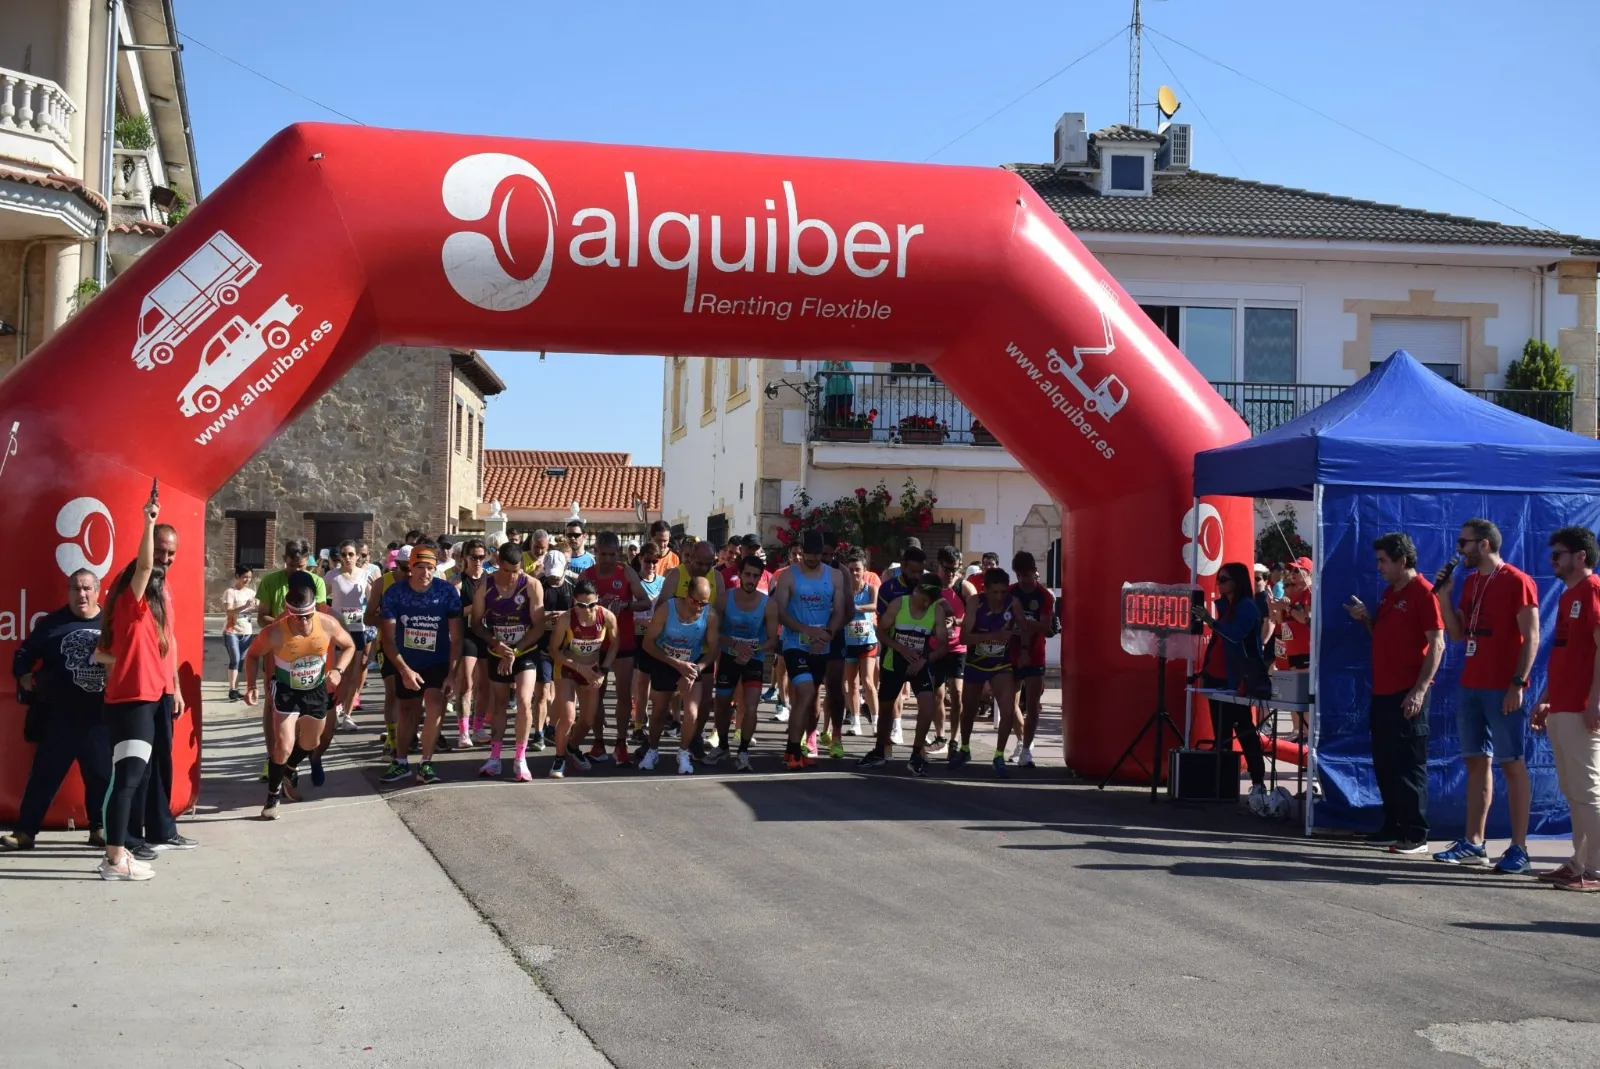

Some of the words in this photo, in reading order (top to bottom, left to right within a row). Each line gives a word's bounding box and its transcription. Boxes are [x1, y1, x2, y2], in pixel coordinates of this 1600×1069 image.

[569, 171, 924, 313] alquiber
[698, 293, 792, 320] Renting
[800, 297, 892, 319] Flexible
[194, 320, 333, 446] www.alquiber.es
[1005, 341, 1116, 460] www.alquiber.es
[503, 633, 516, 641] 97
[854, 626, 864, 634] 38
[413, 636, 427, 645] 68
[300, 675, 314, 685] 53
